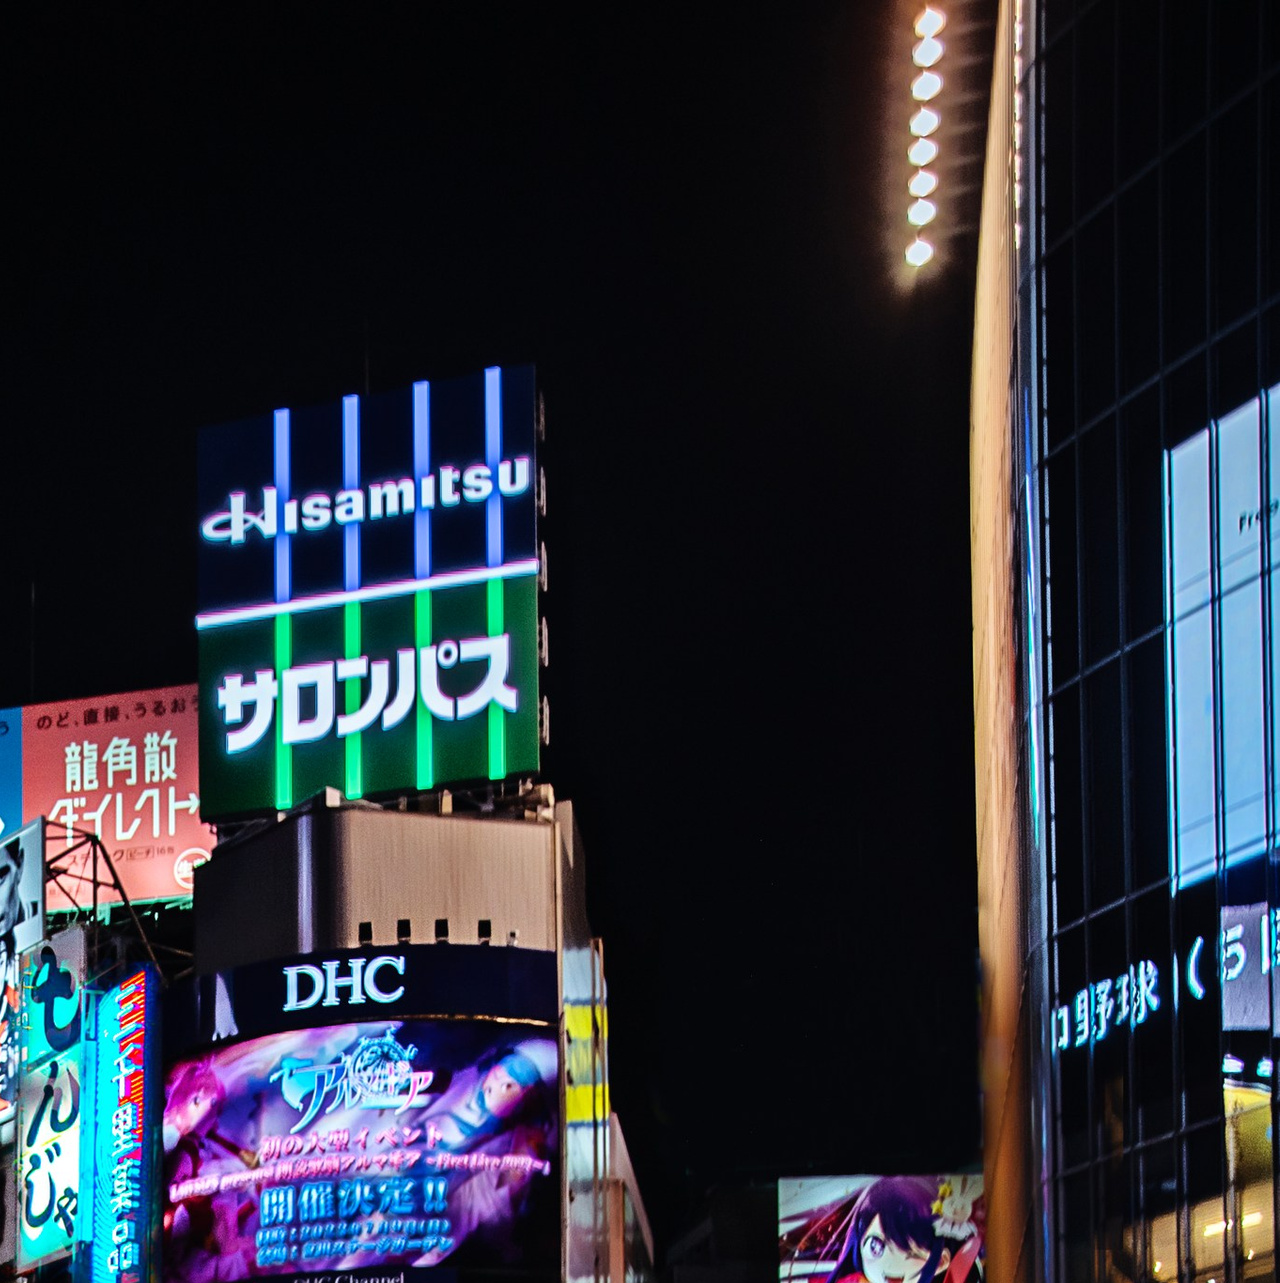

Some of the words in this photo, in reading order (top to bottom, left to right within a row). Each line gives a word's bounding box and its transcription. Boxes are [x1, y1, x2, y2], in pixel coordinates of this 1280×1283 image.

[202, 457, 529, 543] Hisamitsu
[36, 697, 199, 730] のど、直接、うるお
[217, 633, 518, 754] サロンパス
[64, 730, 178, 793] 龍角散
[48, 786, 200, 848] ダイレクト
[68, 847, 124, 866] ステク
[283, 955, 406, 1012] DHC
